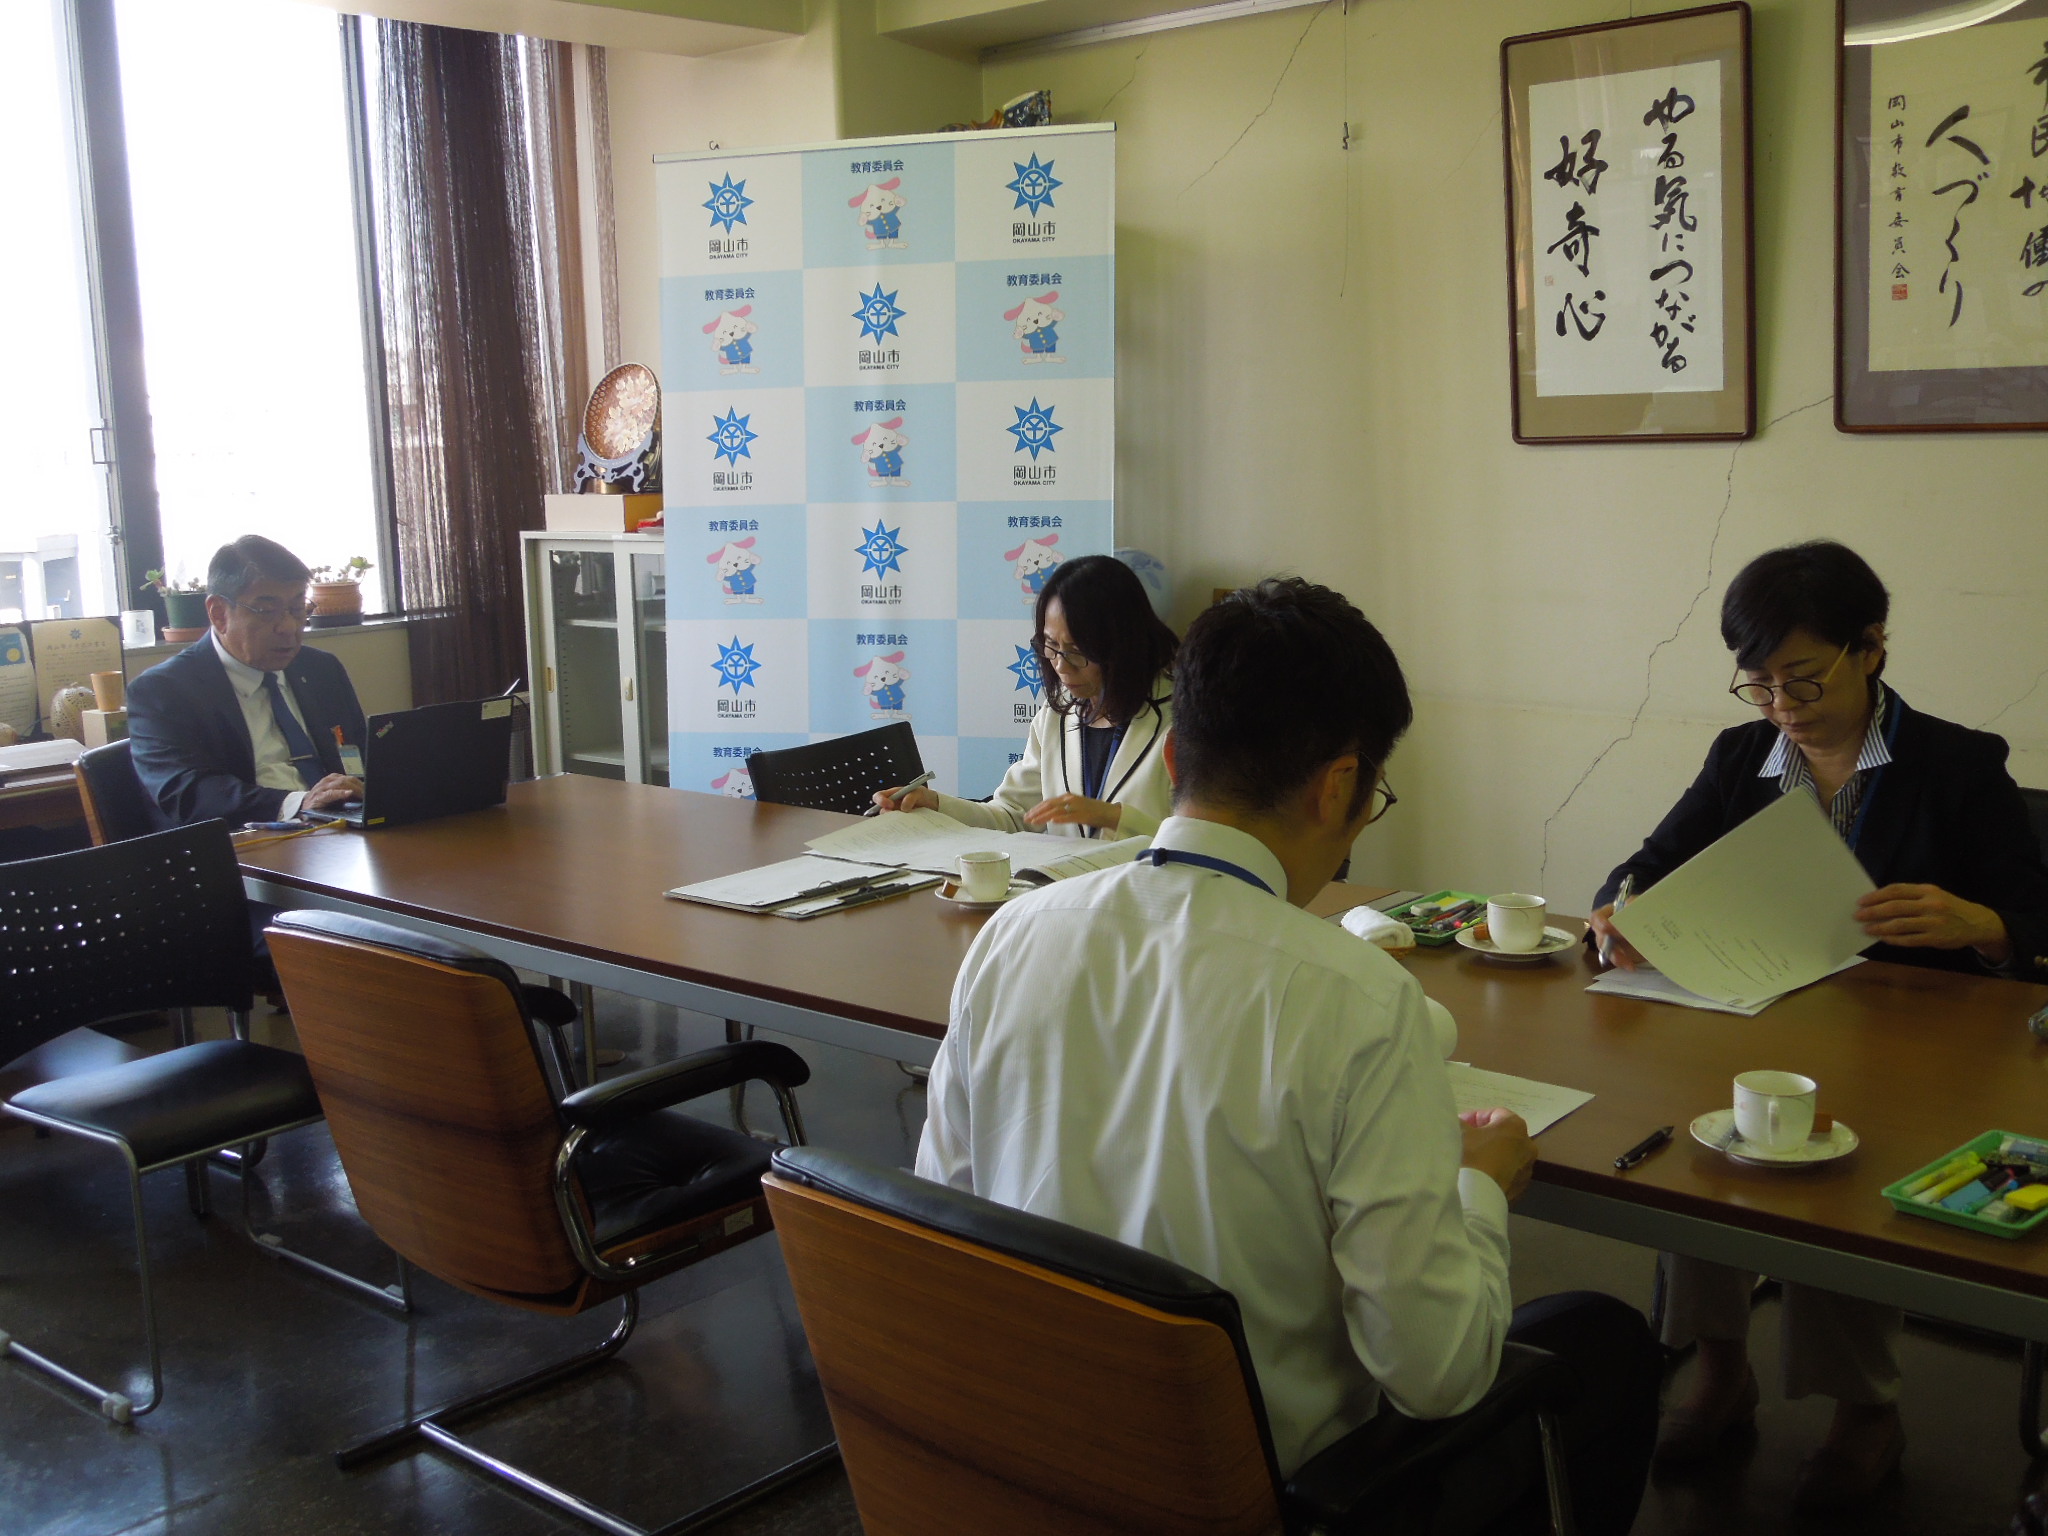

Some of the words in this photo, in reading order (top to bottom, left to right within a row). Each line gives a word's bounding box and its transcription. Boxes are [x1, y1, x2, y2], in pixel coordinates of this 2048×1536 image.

[850, 159, 904, 174] 教育委員会
[1888, 94, 1910, 279] 岡山市教育委員会
[1926, 105, 1990, 327] 人づくり
[1013, 221, 1056, 237] 岡山市
[1544, 129, 1608, 341] 好奇心
[1643, 87, 1697, 373] やる気につながる
[709, 238, 748, 253] 岡山市
[1007, 273, 1062, 286] 教育委員会
[705, 287, 755, 301] 教育委員会
[859, 349, 900, 364] 岡山市
[854, 399, 906, 412] 教育委員会
[713, 471, 752, 485] 岡山市
[1013, 465, 1056, 479] 岡山市
[708, 519, 759, 531] 教育委員会
[1008, 516, 1062, 528] 教育委員会
[861, 584, 902, 598] 岡山市
[856, 634, 908, 645] 教育委員会
[717, 699, 756, 712] 岡山市
[1014, 703, 1041, 717] 岡山
